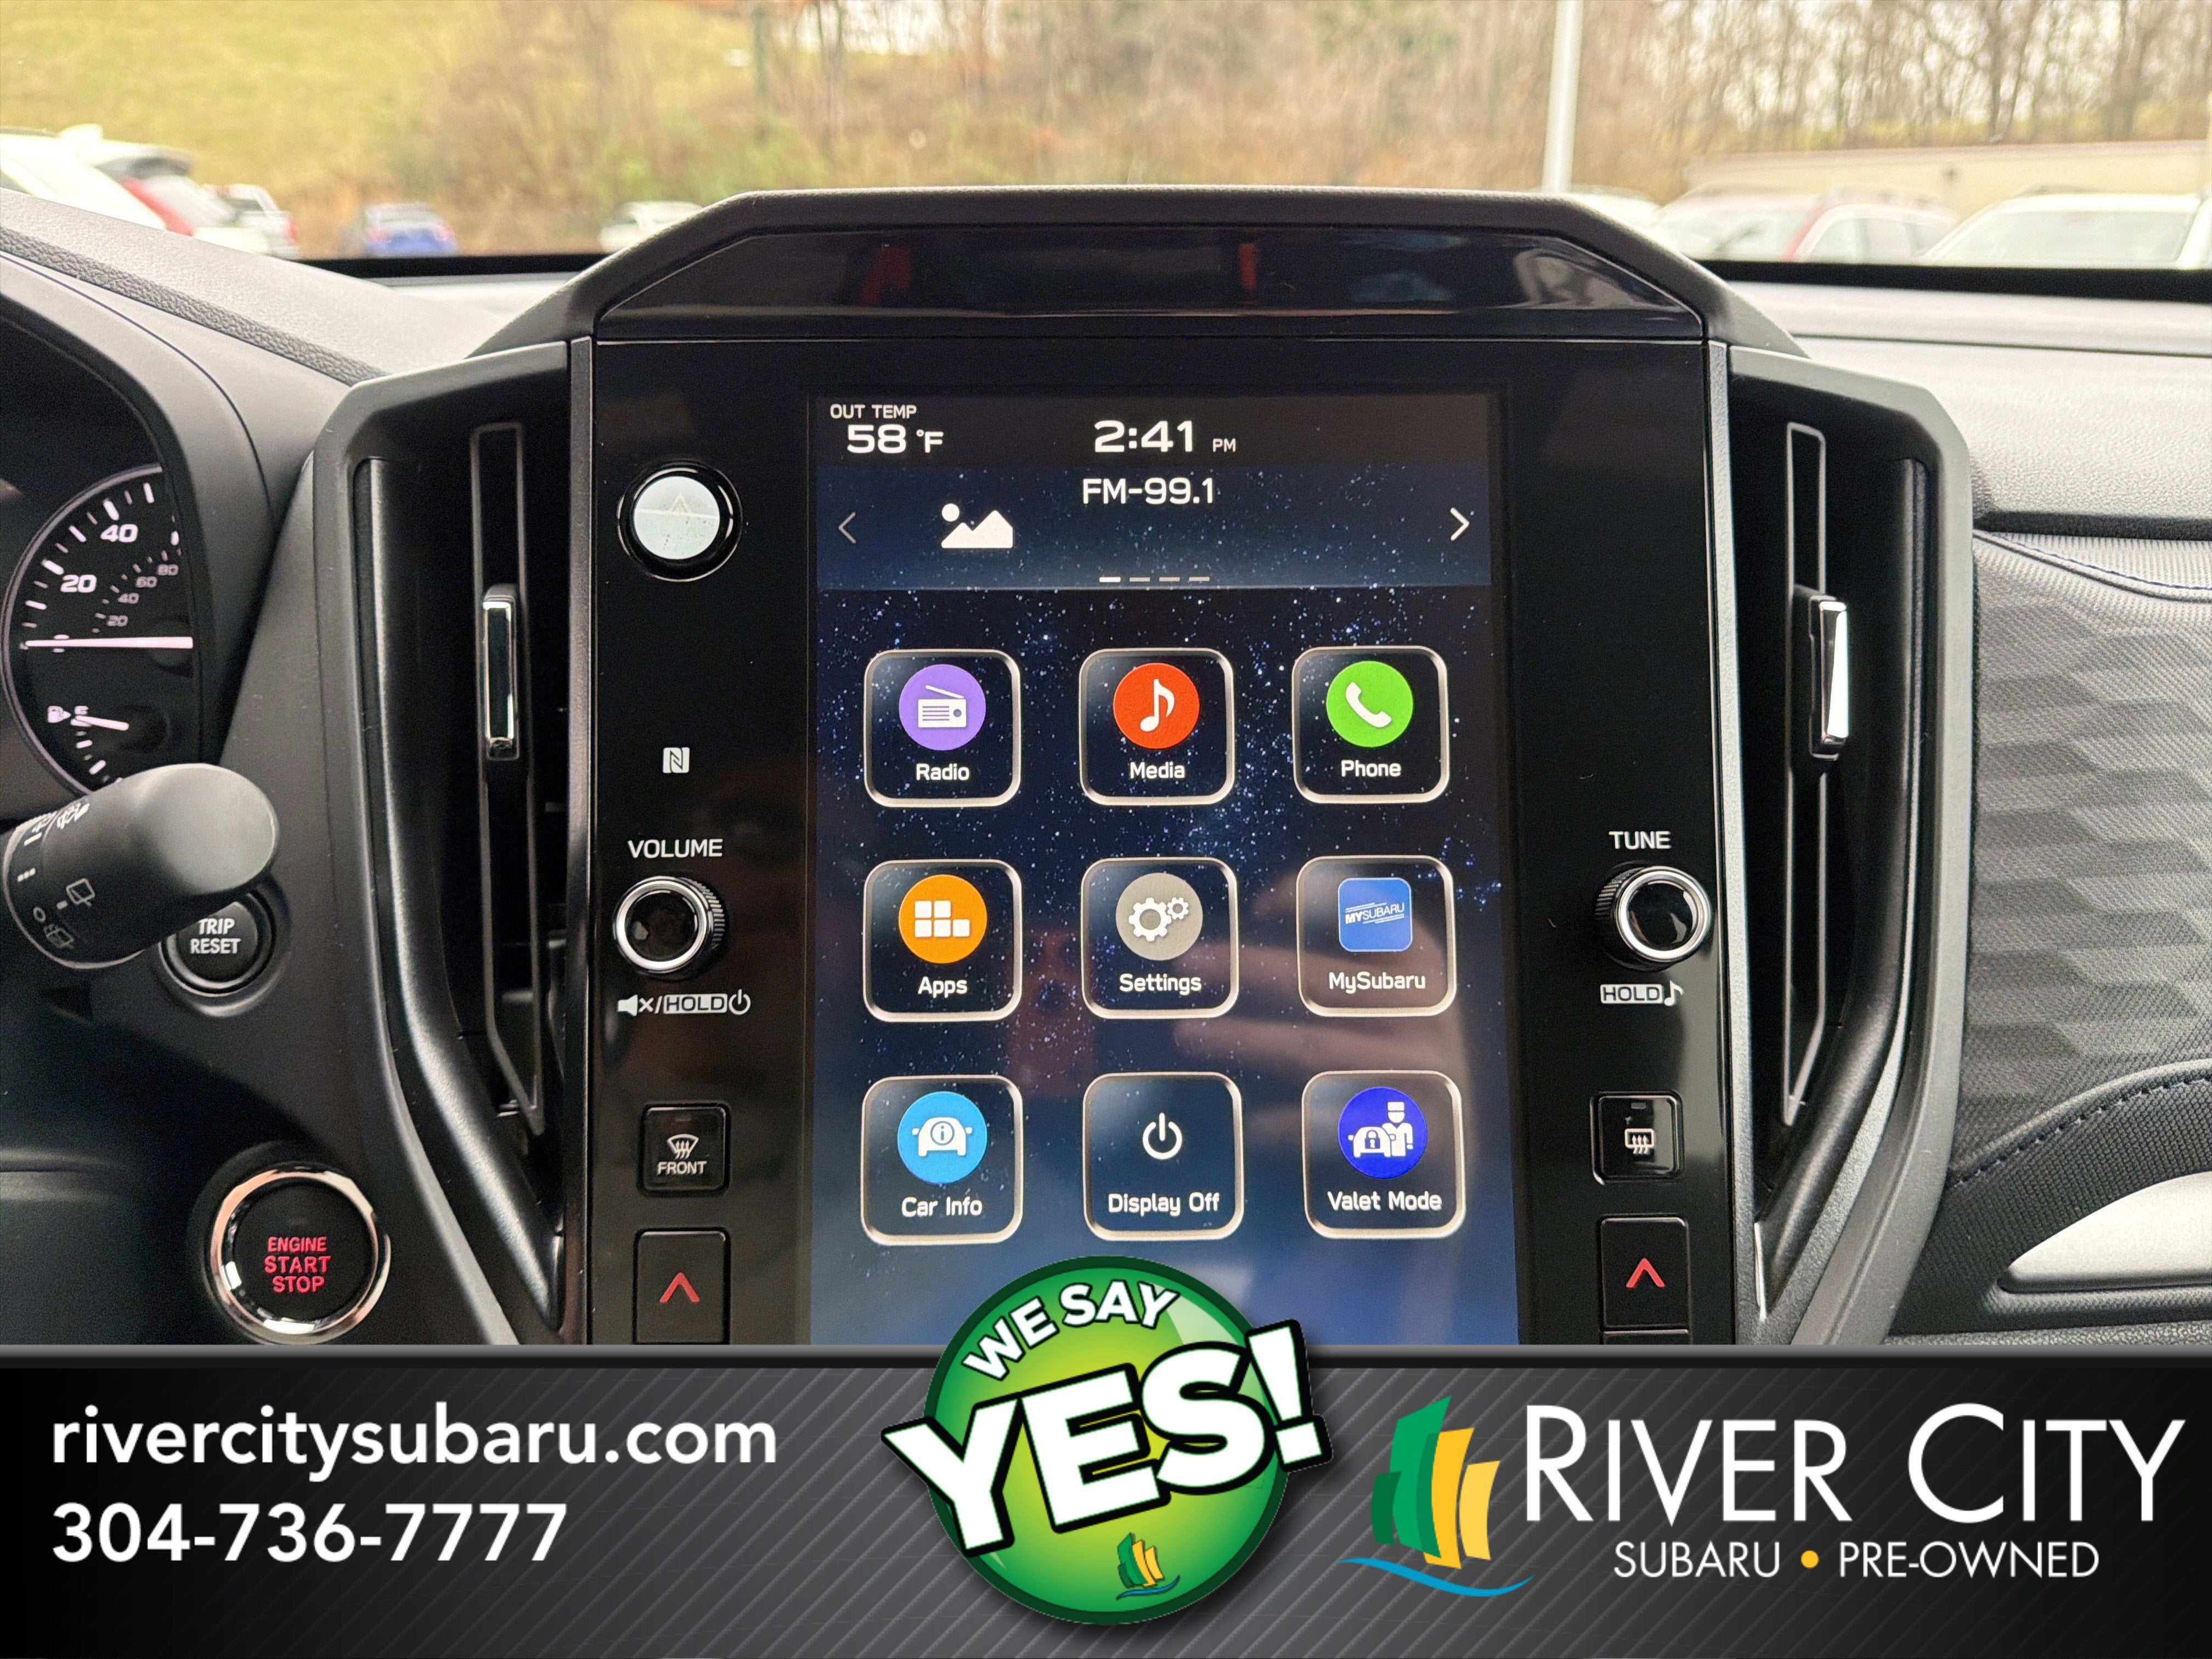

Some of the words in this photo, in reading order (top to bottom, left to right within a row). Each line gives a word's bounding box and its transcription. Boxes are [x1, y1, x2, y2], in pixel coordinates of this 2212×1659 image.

[830, 404, 866, 419] OUT
[871, 404, 917, 419] TEMP
[847, 424, 906, 454] 58
[1094, 420, 1193, 453] 2:41
[1212, 438, 1236, 453] PM
[1083, 477, 1213, 505] FM-99.1
[100, 524, 138, 543] 40
[59, 572, 97, 593] 20
[118, 592, 139, 604] 40
[107, 615, 128, 627] 20
[916, 763, 970, 781] Radio
[1130, 761, 1185, 779] Media
[1341, 759, 1402, 777] Phone
[628, 838, 723, 859] VOLUME
[1609, 831, 1671, 850] TUNE
[199, 918, 235, 935] TRIP
[190, 938, 241, 954] RESET
[918, 976, 968, 998] Apps
[1119, 973, 1202, 996] Settings
[1329, 971, 1426, 994] MySubaru
[1601, 986, 1661, 1003] HOLD
[657, 1161, 707, 1175] FRONT
[901, 1197, 939, 1217] Car
[946, 1196, 983, 1216] Info
[1108, 1193, 1181, 1217] Display
[1189, 1192, 1220, 1212] Off
[1327, 1191, 1381, 1211] Valet
[1388, 1190, 1442, 1211] Mode
[267, 1237, 327, 1253] ENGINE
[264, 1255, 331, 1274] START
[272, 1276, 325, 1293] STOP
